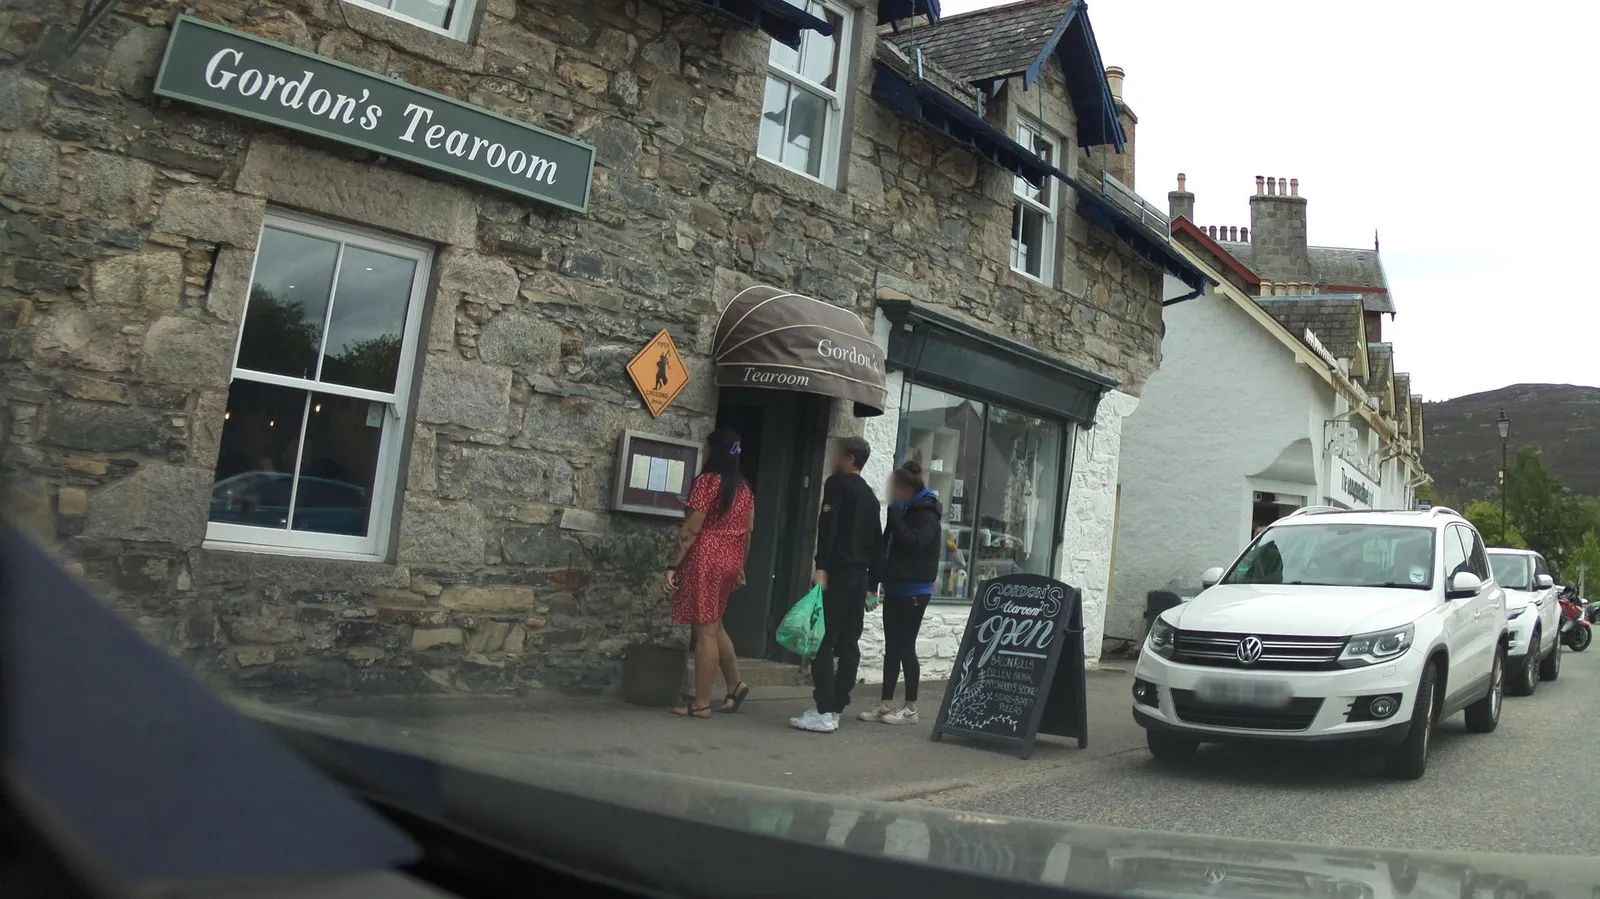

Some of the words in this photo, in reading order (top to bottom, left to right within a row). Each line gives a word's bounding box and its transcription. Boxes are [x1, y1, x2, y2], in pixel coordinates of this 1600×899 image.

[204, 47, 383, 131] Gordon's
[398, 103, 558, 185] Tearoom
[817, 338, 879, 373] Gordon's
[743, 367, 809, 387] Tearoom
[646, 389, 669, 399] CROSSING
[983, 582, 1064, 618] GORDON'S
[1001, 600, 1043, 616] tearoom
